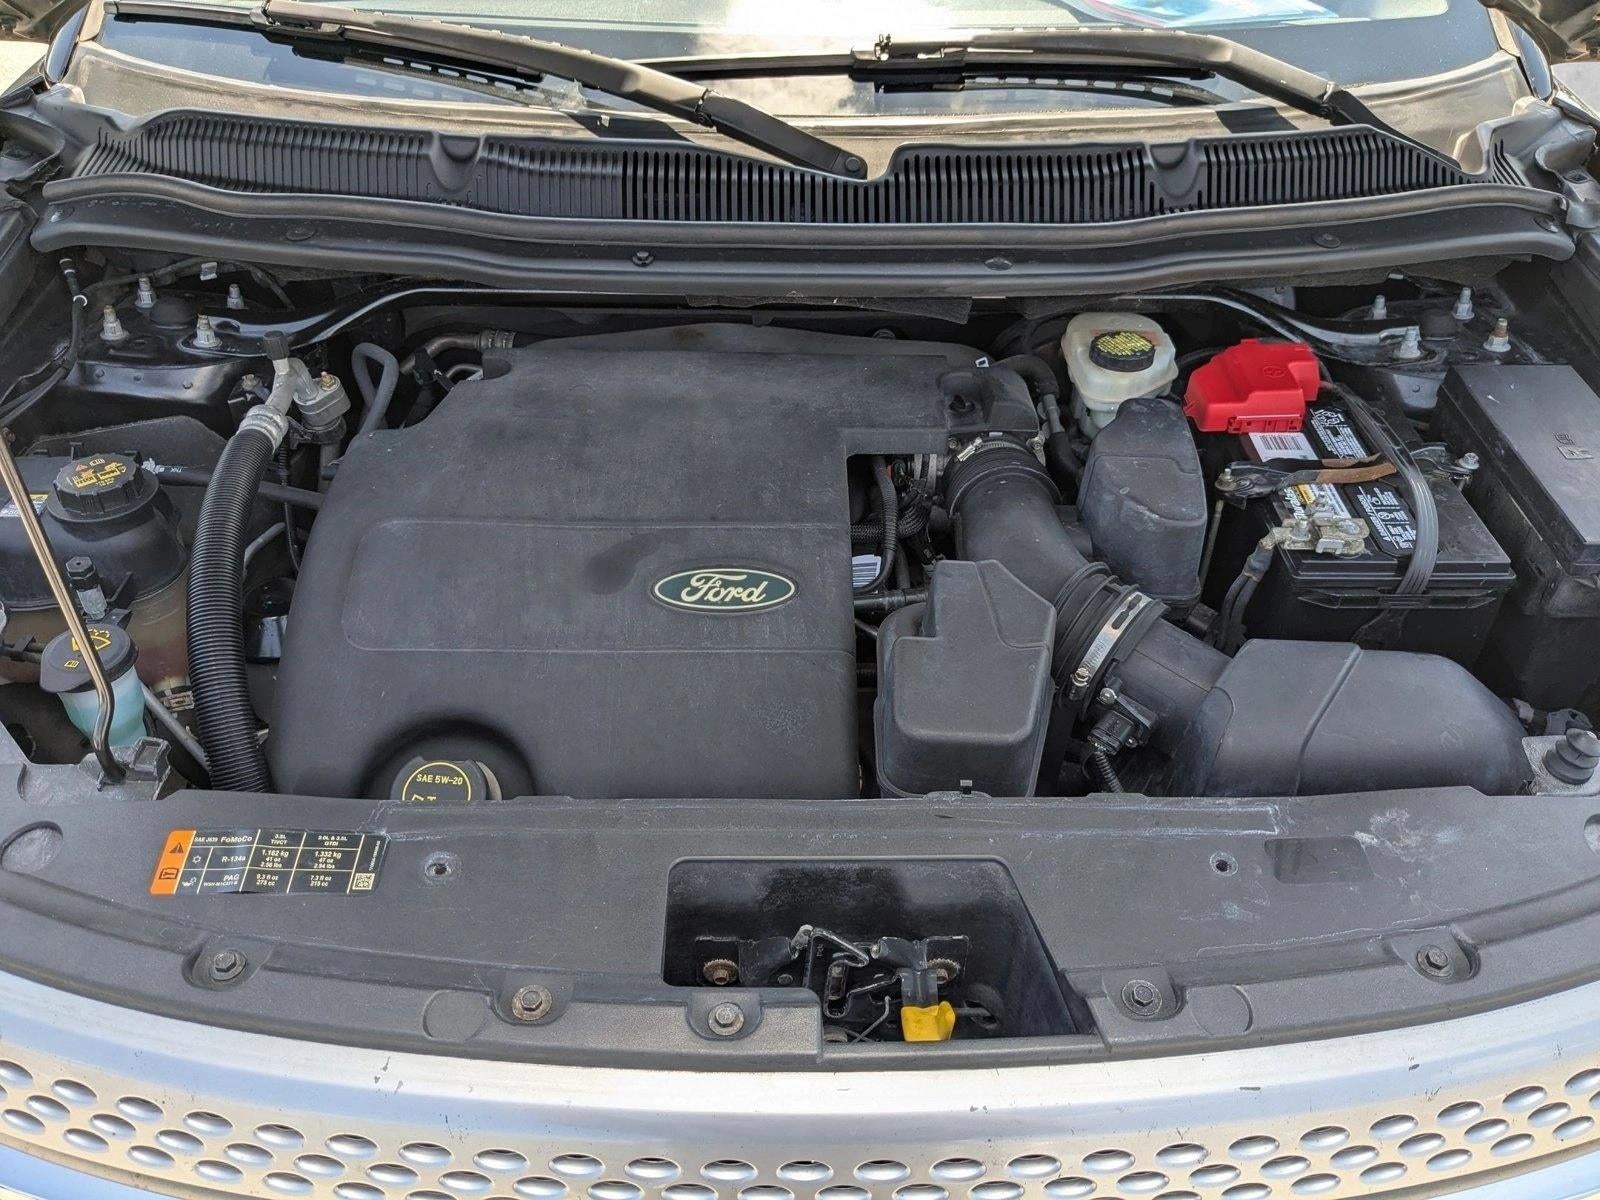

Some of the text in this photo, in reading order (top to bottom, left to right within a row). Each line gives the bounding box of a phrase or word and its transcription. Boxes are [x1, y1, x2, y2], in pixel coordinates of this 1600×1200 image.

[680, 573, 769, 603] Ford
[417, 773, 463, 785] SAE 5W-20
[280, 850, 290, 859] kg
[332, 851, 342, 860] kg
